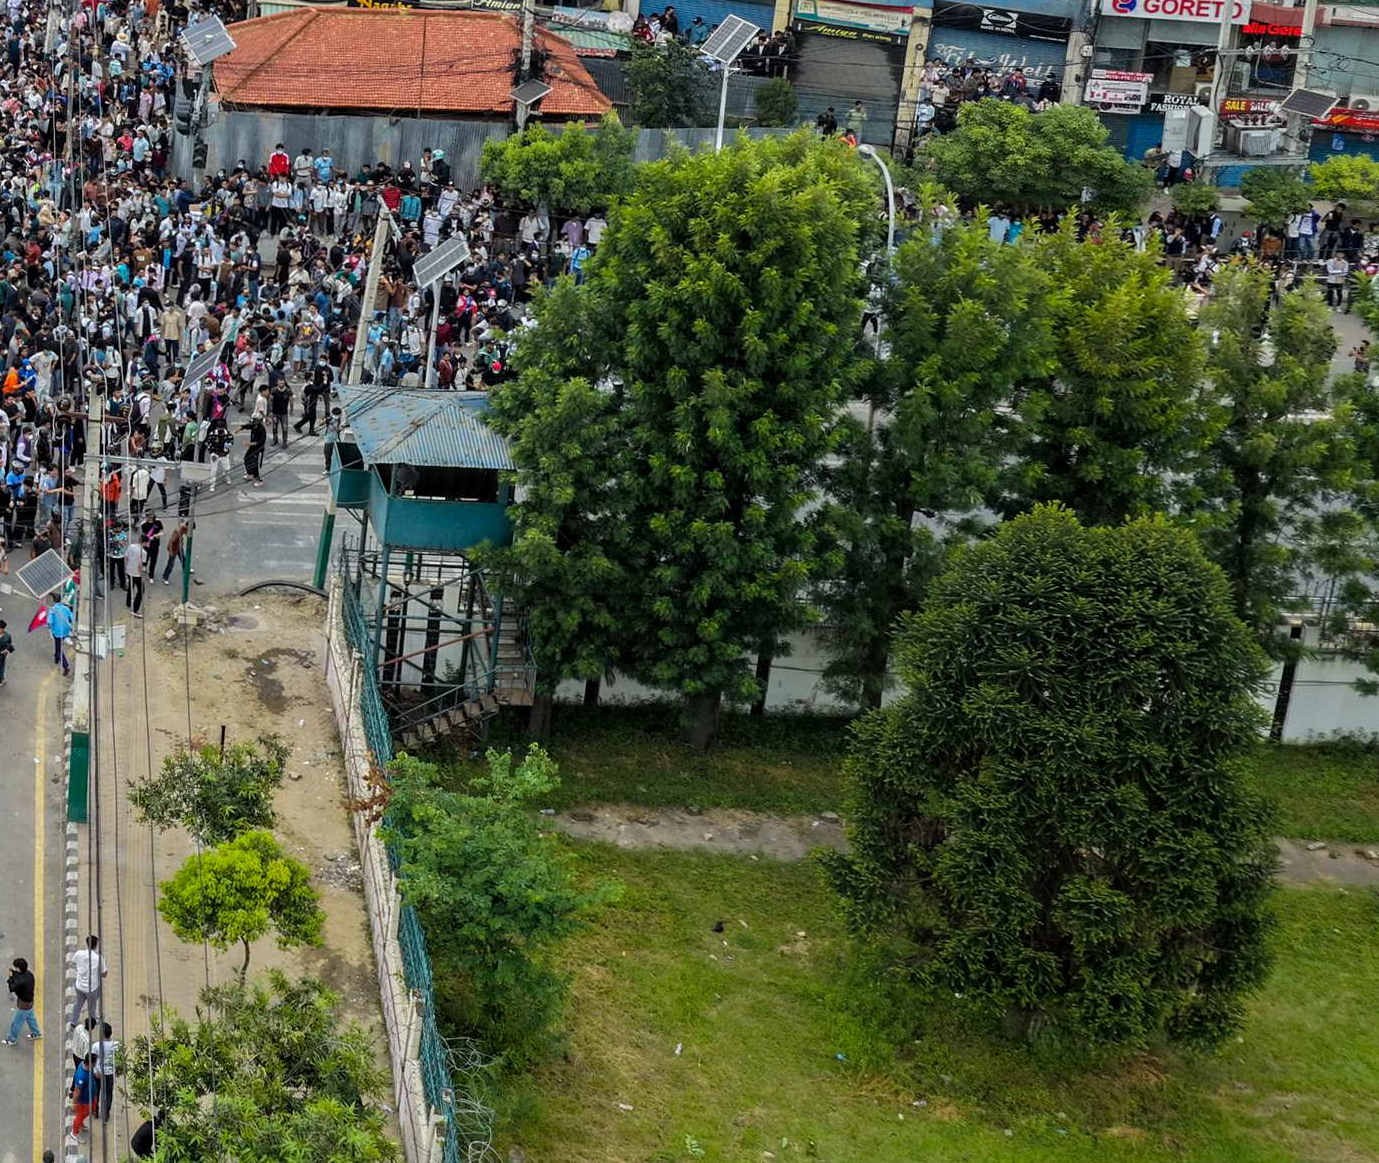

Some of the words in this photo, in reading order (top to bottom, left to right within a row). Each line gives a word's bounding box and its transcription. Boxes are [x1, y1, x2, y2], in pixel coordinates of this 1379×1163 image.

[1163, 94, 1200, 105] ROYAL
[1150, 102, 1191, 111] FASHION
[1225, 100, 1246, 111] SALE
